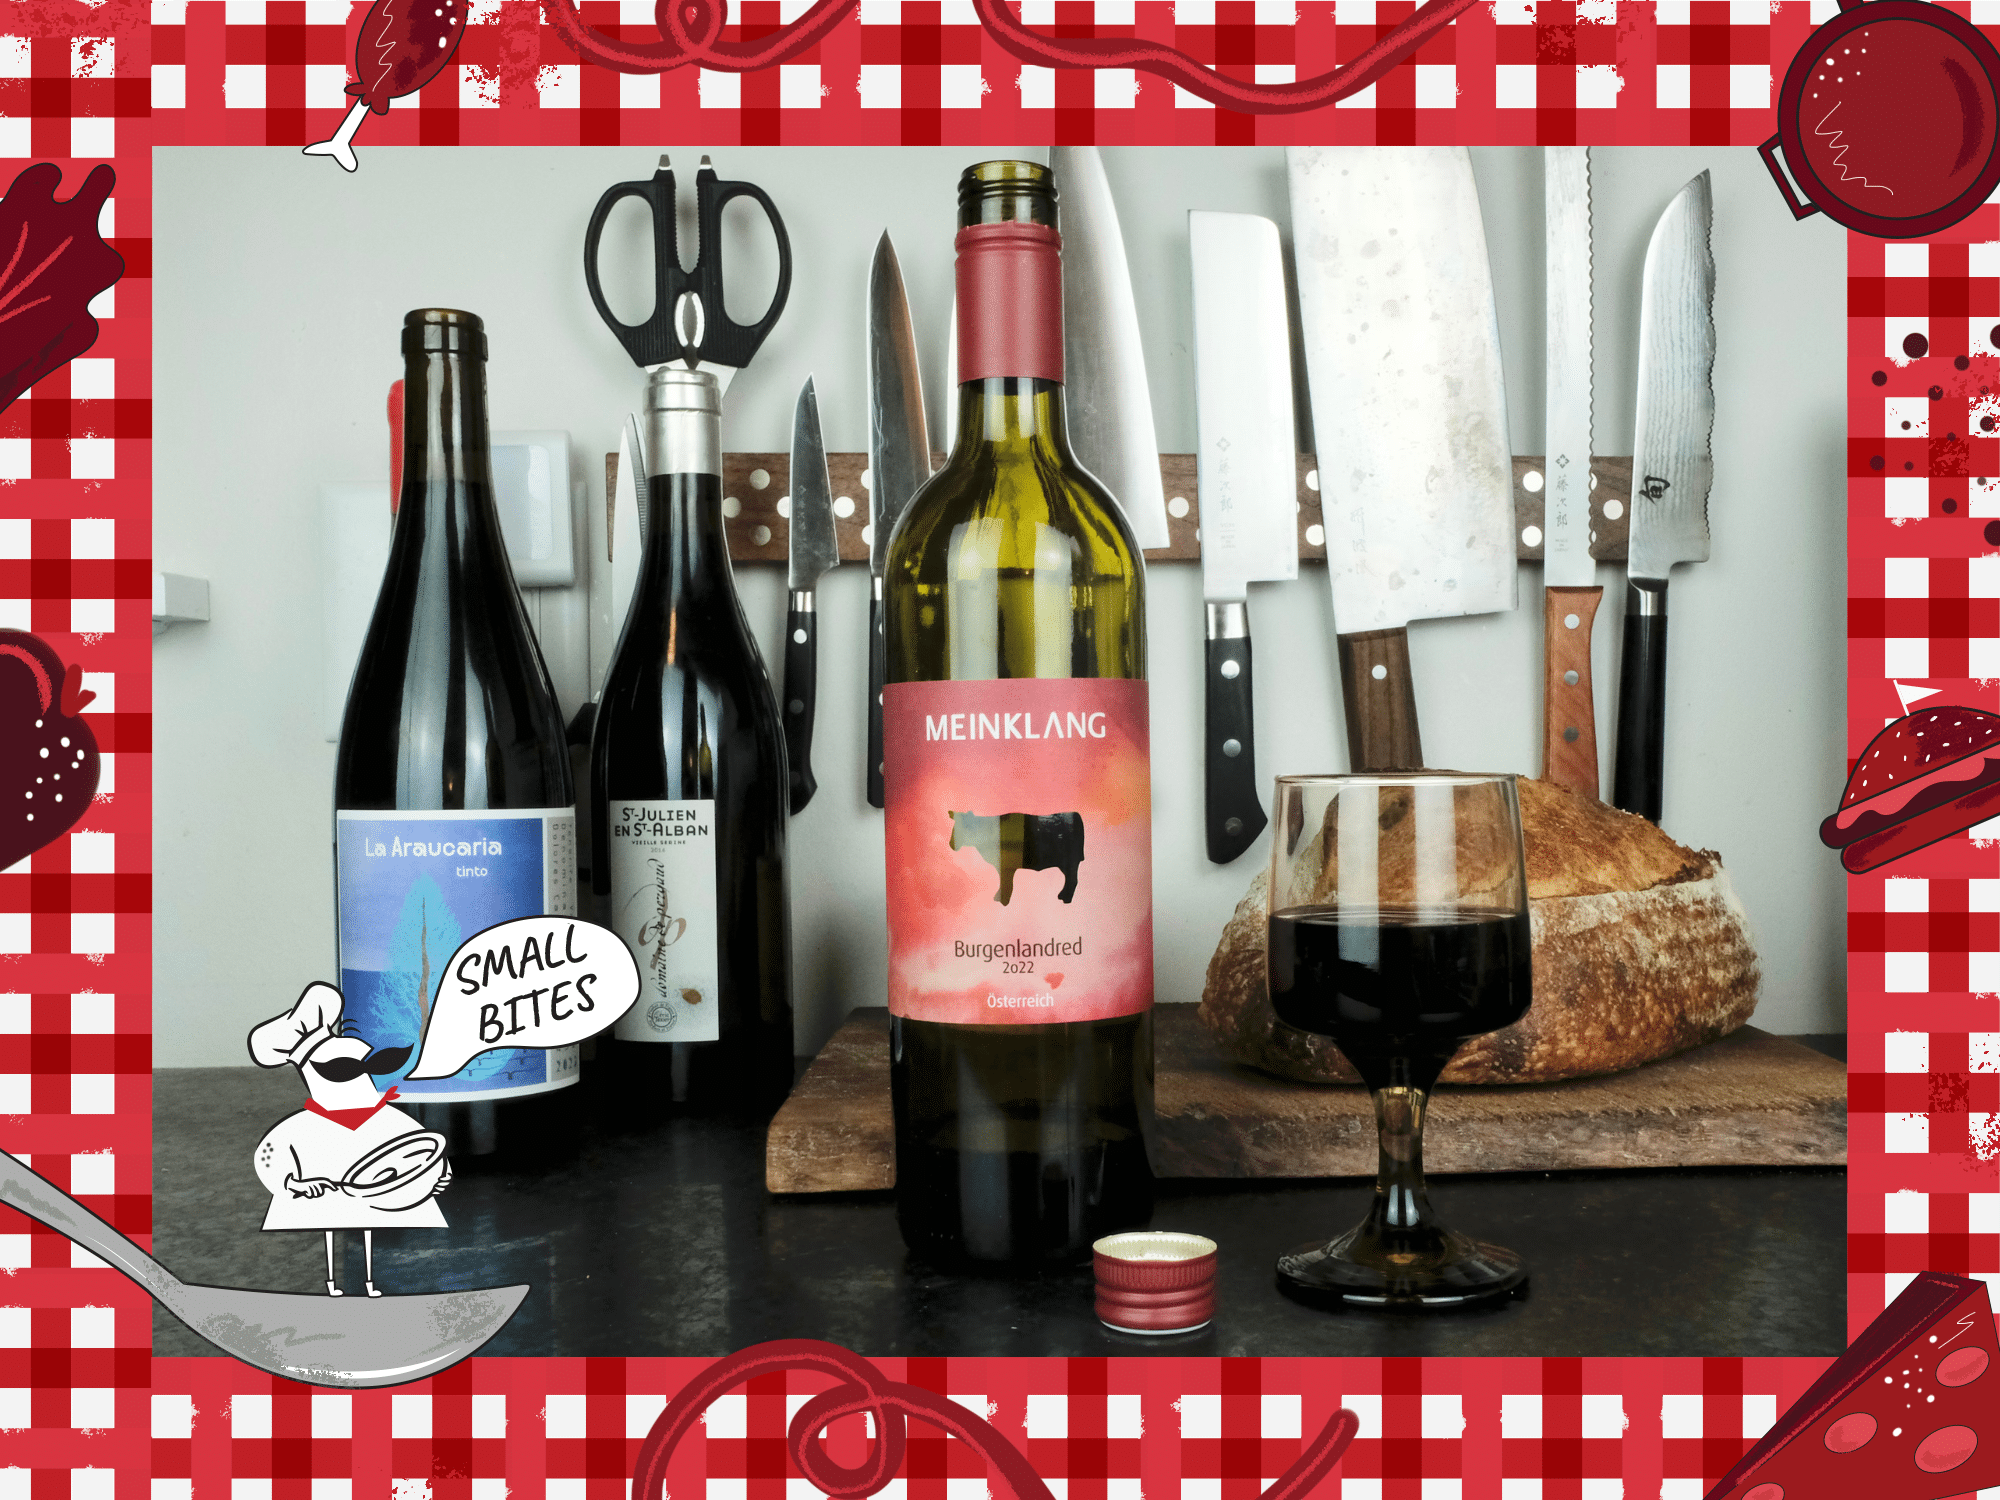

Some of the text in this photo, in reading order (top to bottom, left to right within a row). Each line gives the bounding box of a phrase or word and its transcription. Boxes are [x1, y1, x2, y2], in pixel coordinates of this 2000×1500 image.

[925, 711, 1106, 741] MEINKLANG
[614, 825, 631, 837] EN
[365, 836, 502, 857] La Araucaria
[552, 823, 560, 885] Dolores
[456, 866, 488, 877] tinto
[954, 936, 1083, 962] Burgenlandred
[1002, 961, 1034, 974] 2022
[987, 992, 1054, 1008] Österreich
